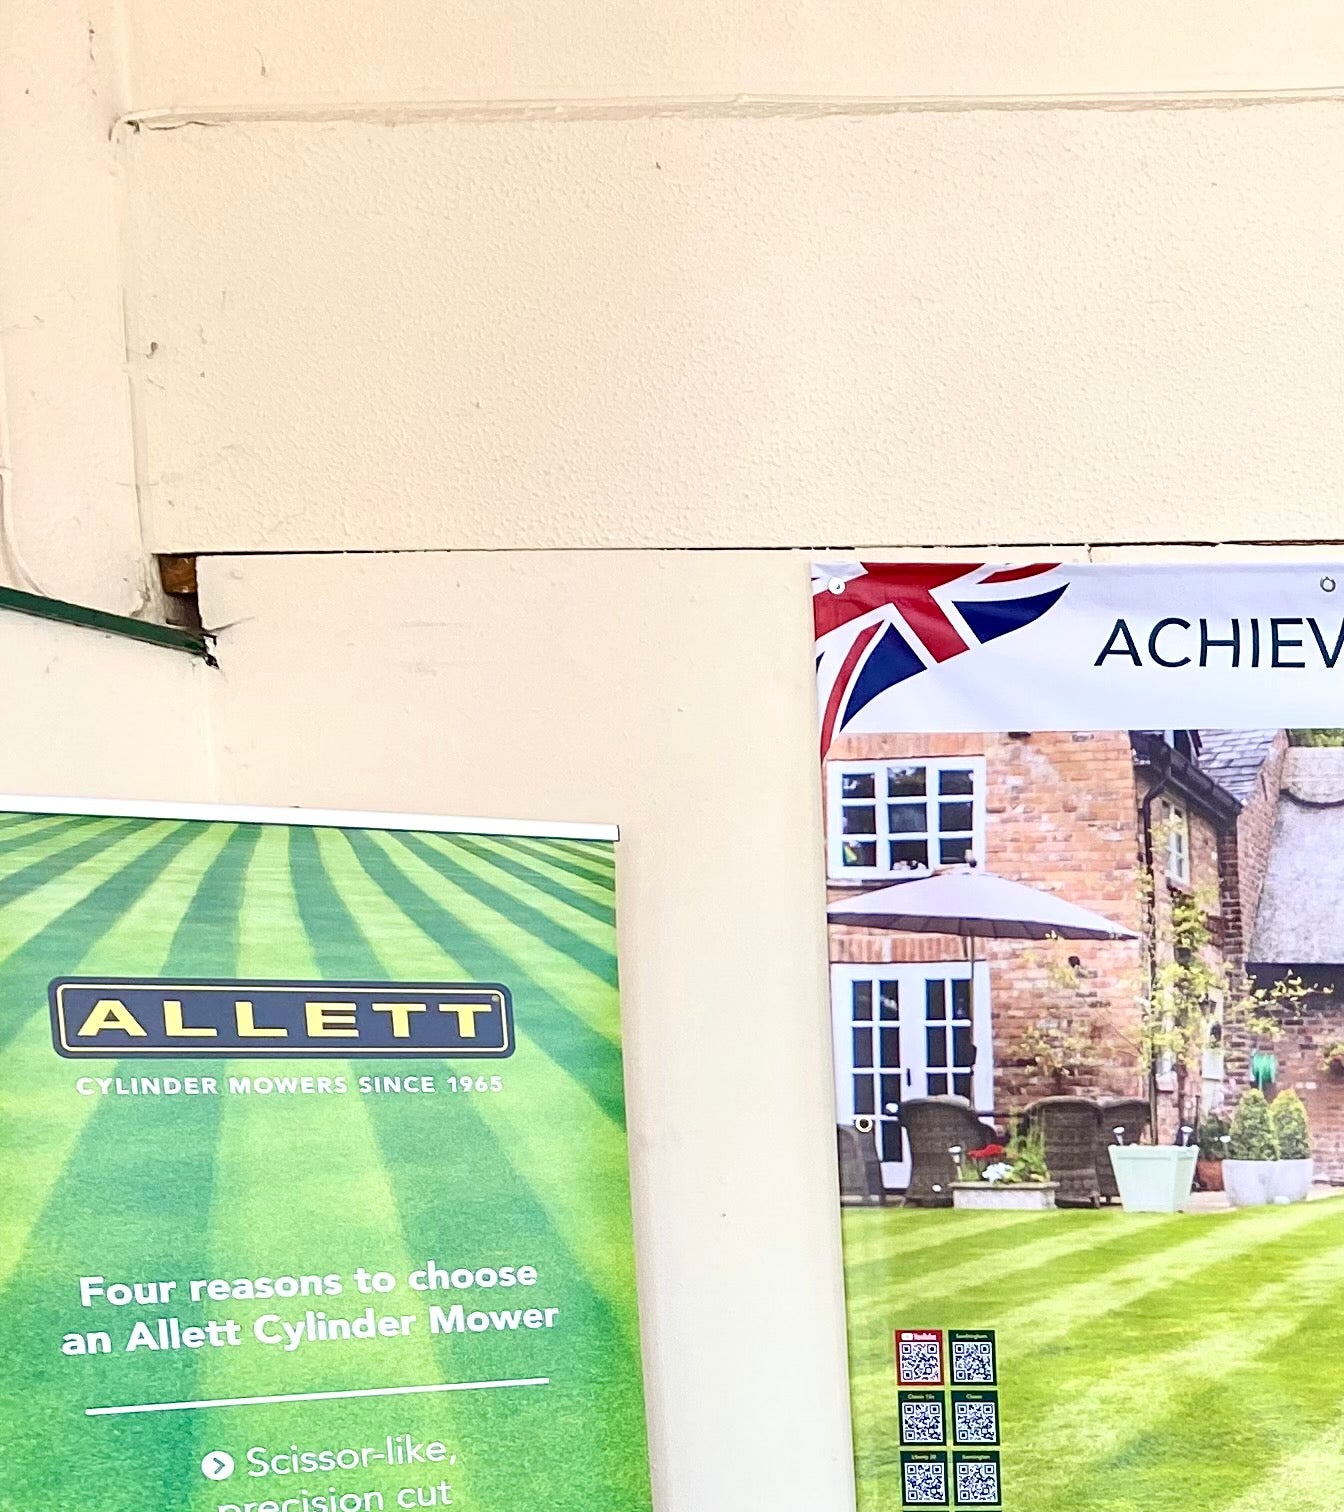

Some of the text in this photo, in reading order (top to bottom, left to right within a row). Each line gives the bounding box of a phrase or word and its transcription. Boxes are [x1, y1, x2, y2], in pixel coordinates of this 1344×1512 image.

[77, 999, 493, 1038] ALLETT
[76, 1075, 503, 1096] CYLINDER MOWERS SINCE 1965
[79, 1260, 538, 1307] Four reasons to choose
[62, 1304, 559, 1355] an Allett Cylinder Mower
[246, 1434, 458, 1478] Scissor-like,
[397, 1481, 454, 1510] cut
